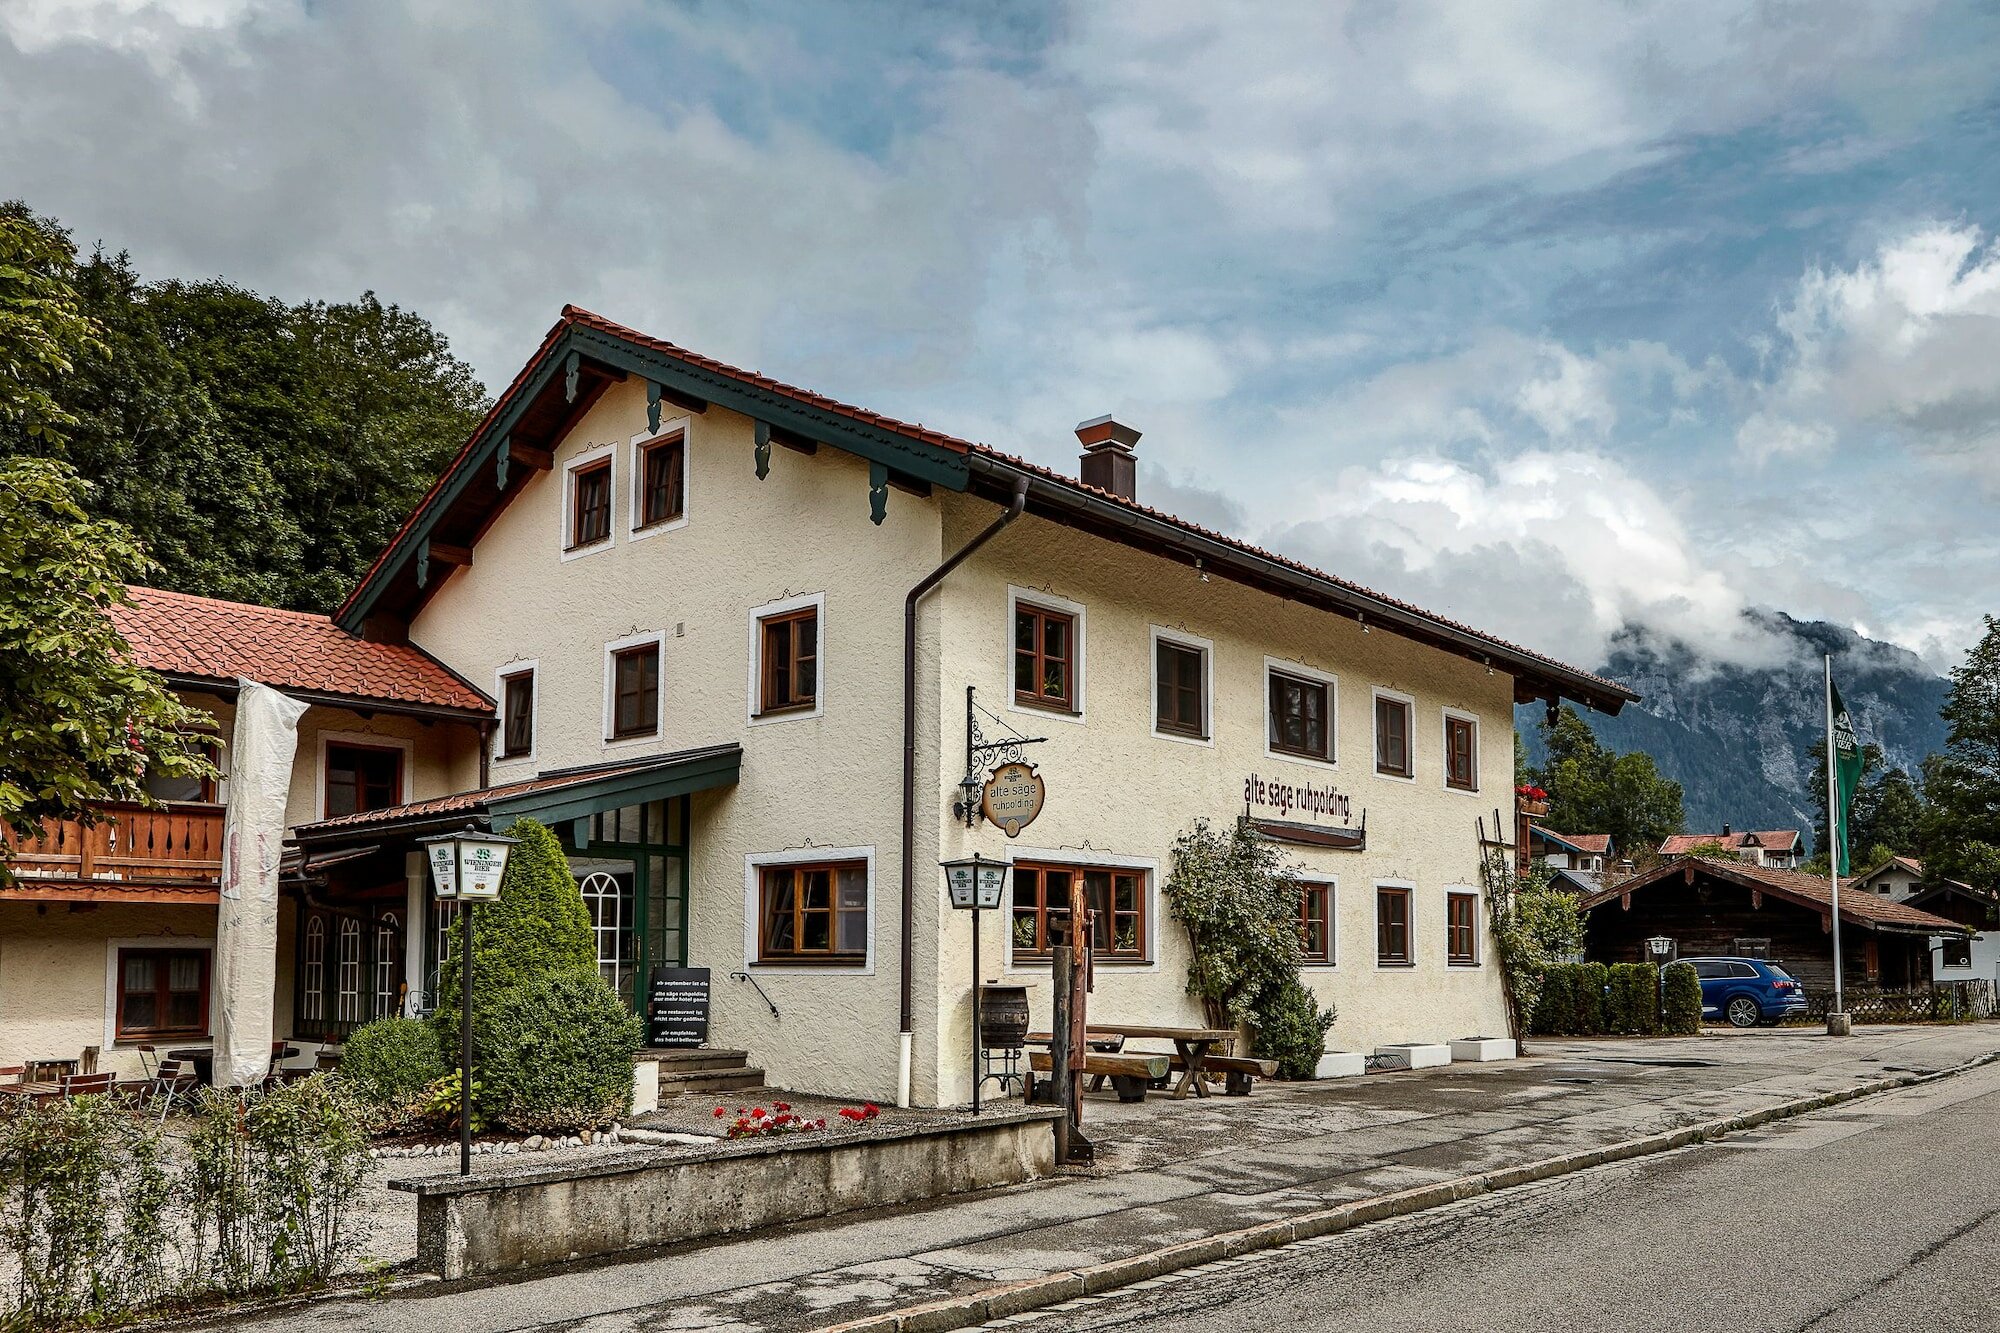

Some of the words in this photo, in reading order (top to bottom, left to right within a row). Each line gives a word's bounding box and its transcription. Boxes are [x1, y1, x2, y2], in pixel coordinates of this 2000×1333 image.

[990, 786, 1009, 797] alte
[1012, 783, 1036, 797] säge
[1244, 772, 1266, 805] alte
[1268, 776, 1293, 816] säge
[1296, 781, 1352, 825] ruhpolding.
[464, 859, 502, 868] WIENINGER
